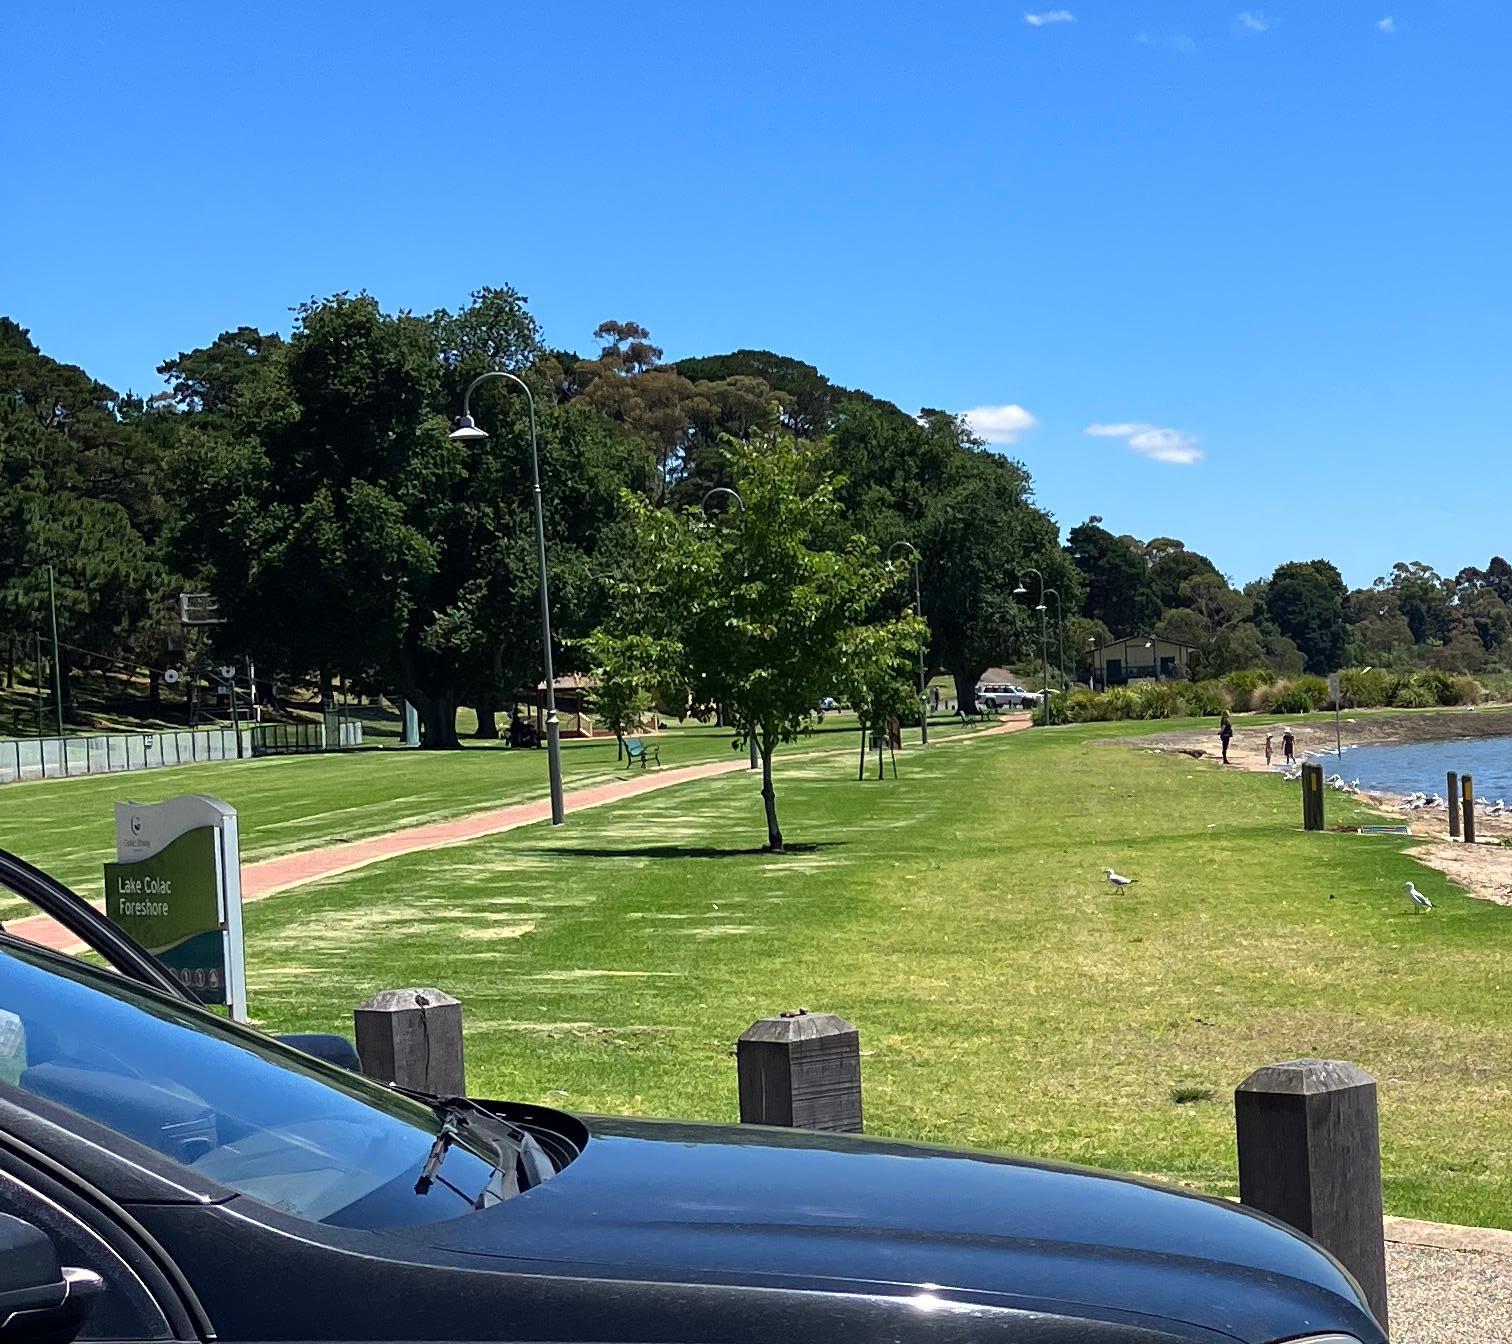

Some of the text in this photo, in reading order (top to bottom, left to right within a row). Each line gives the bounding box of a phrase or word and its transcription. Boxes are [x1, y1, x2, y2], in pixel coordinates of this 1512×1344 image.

[119, 877, 172, 894] Lake Colac
[119, 898, 168, 916] Foreshore
